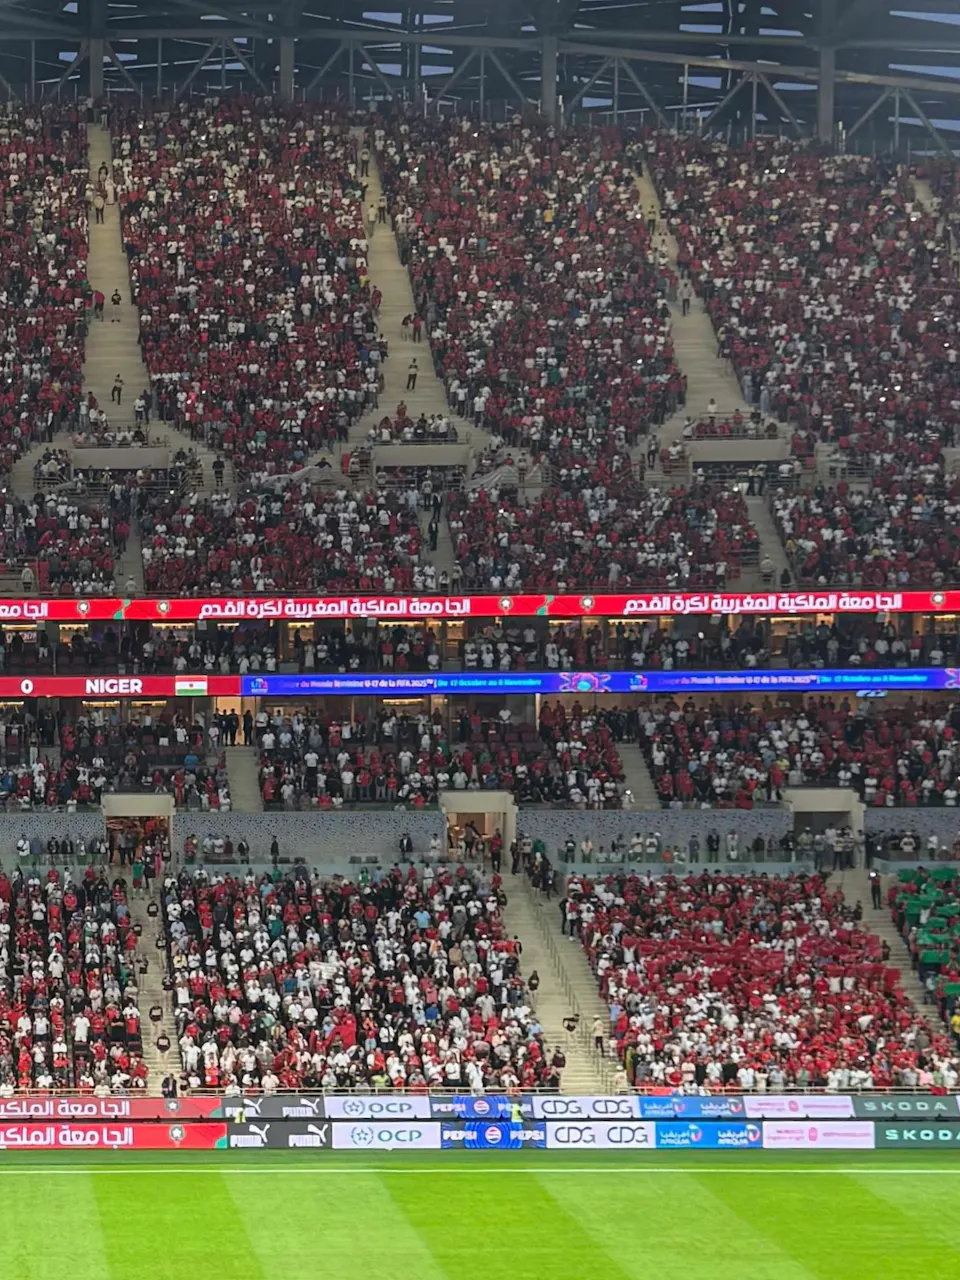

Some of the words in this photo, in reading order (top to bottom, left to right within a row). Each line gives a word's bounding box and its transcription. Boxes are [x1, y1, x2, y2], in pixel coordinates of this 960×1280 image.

[20, 680, 33, 694] 0
[85, 679, 143, 694] NIGER
[58, 1099, 130, 1118] الجامعة
[368, 1102, 412, 1112] OCP
[432, 1103, 465, 1111] PEPSI
[541, 1100, 582, 1114] CDG
[592, 1100, 632, 1114] CDG
[59, 1124, 134, 1149] الجامعة
[378, 1129, 422, 1141] OCP
[554, 1127, 596, 1144] CDG
[607, 1127, 648, 1144] CDG
